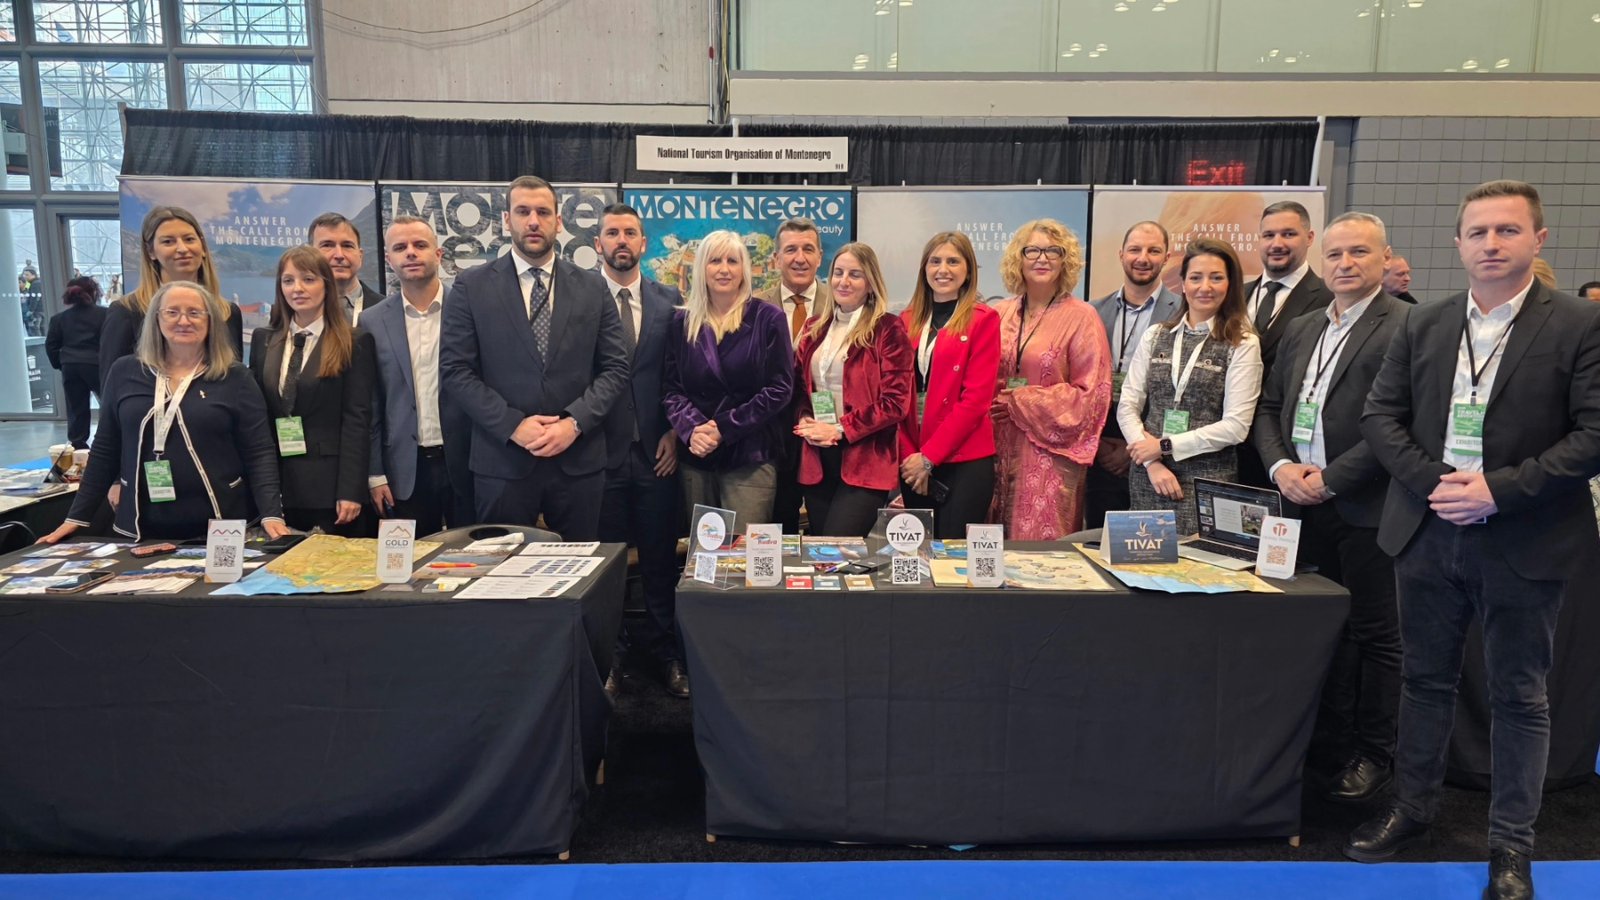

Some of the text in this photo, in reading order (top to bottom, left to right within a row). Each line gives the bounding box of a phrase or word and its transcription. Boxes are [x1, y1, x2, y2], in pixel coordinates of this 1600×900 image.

[657, 147, 832, 161] National Tourism Organisation of Montenegro
[1188, 159, 1246, 185] Exit
[234, 216, 287, 226] ANSWER
[210, 225, 233, 235] THE
[240, 226, 270, 236] CALL
[816, 224, 844, 236] eauty
[956, 222, 1003, 232] ANSWER
[1192, 223, 1240, 232] ANSWER
[968, 232, 1014, 241] ALL FRO
[1171, 233, 1191, 242] THE
[888, 532, 922, 542] TIVAT
[972, 541, 999, 549] TIVAT
[1124, 538, 1164, 550] TIVAT
